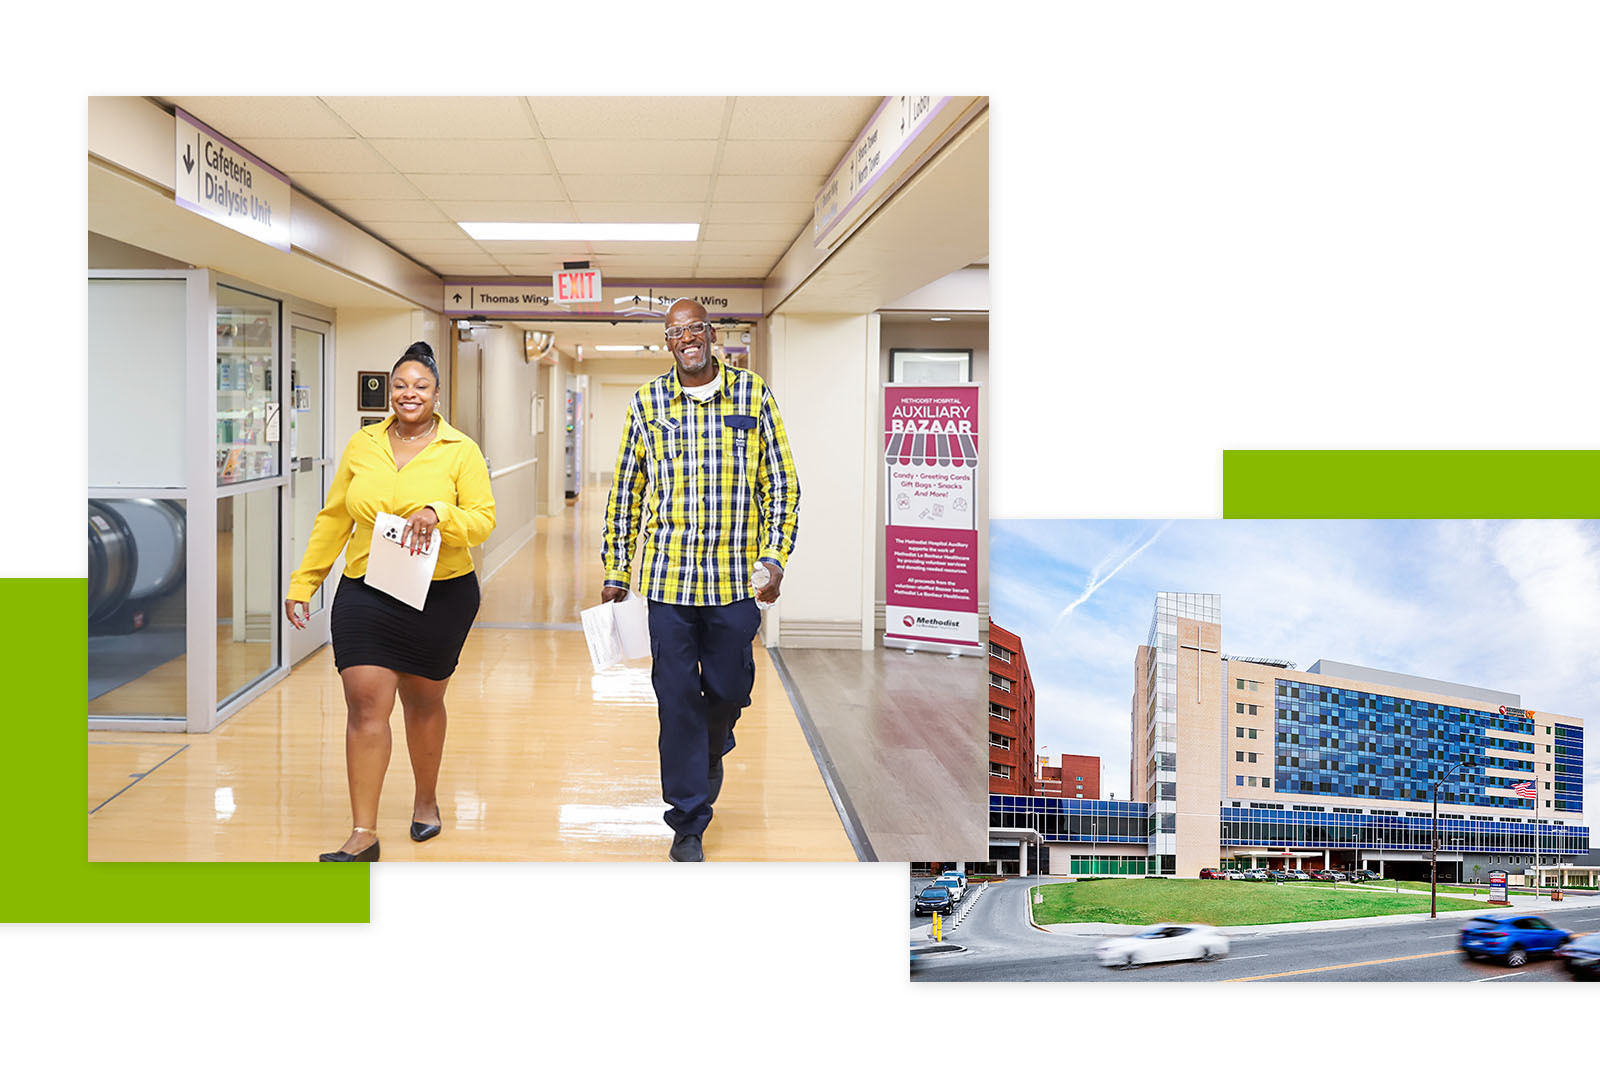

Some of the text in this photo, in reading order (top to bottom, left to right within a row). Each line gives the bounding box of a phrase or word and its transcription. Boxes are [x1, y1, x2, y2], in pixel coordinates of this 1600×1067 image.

[205, 140, 252, 189] Cafeteria
[205, 171, 272, 227] Dialysis Unit
[558, 272, 596, 300] EXIT
[479, 294, 549, 306] Thomas Wing
[700, 296, 729, 308] Wing
[892, 405, 971, 418] AUXILIARY
[891, 419, 973, 434] BAZAAR
[920, 473, 949, 481] Greeting
[916, 617, 960, 627] Methodist
